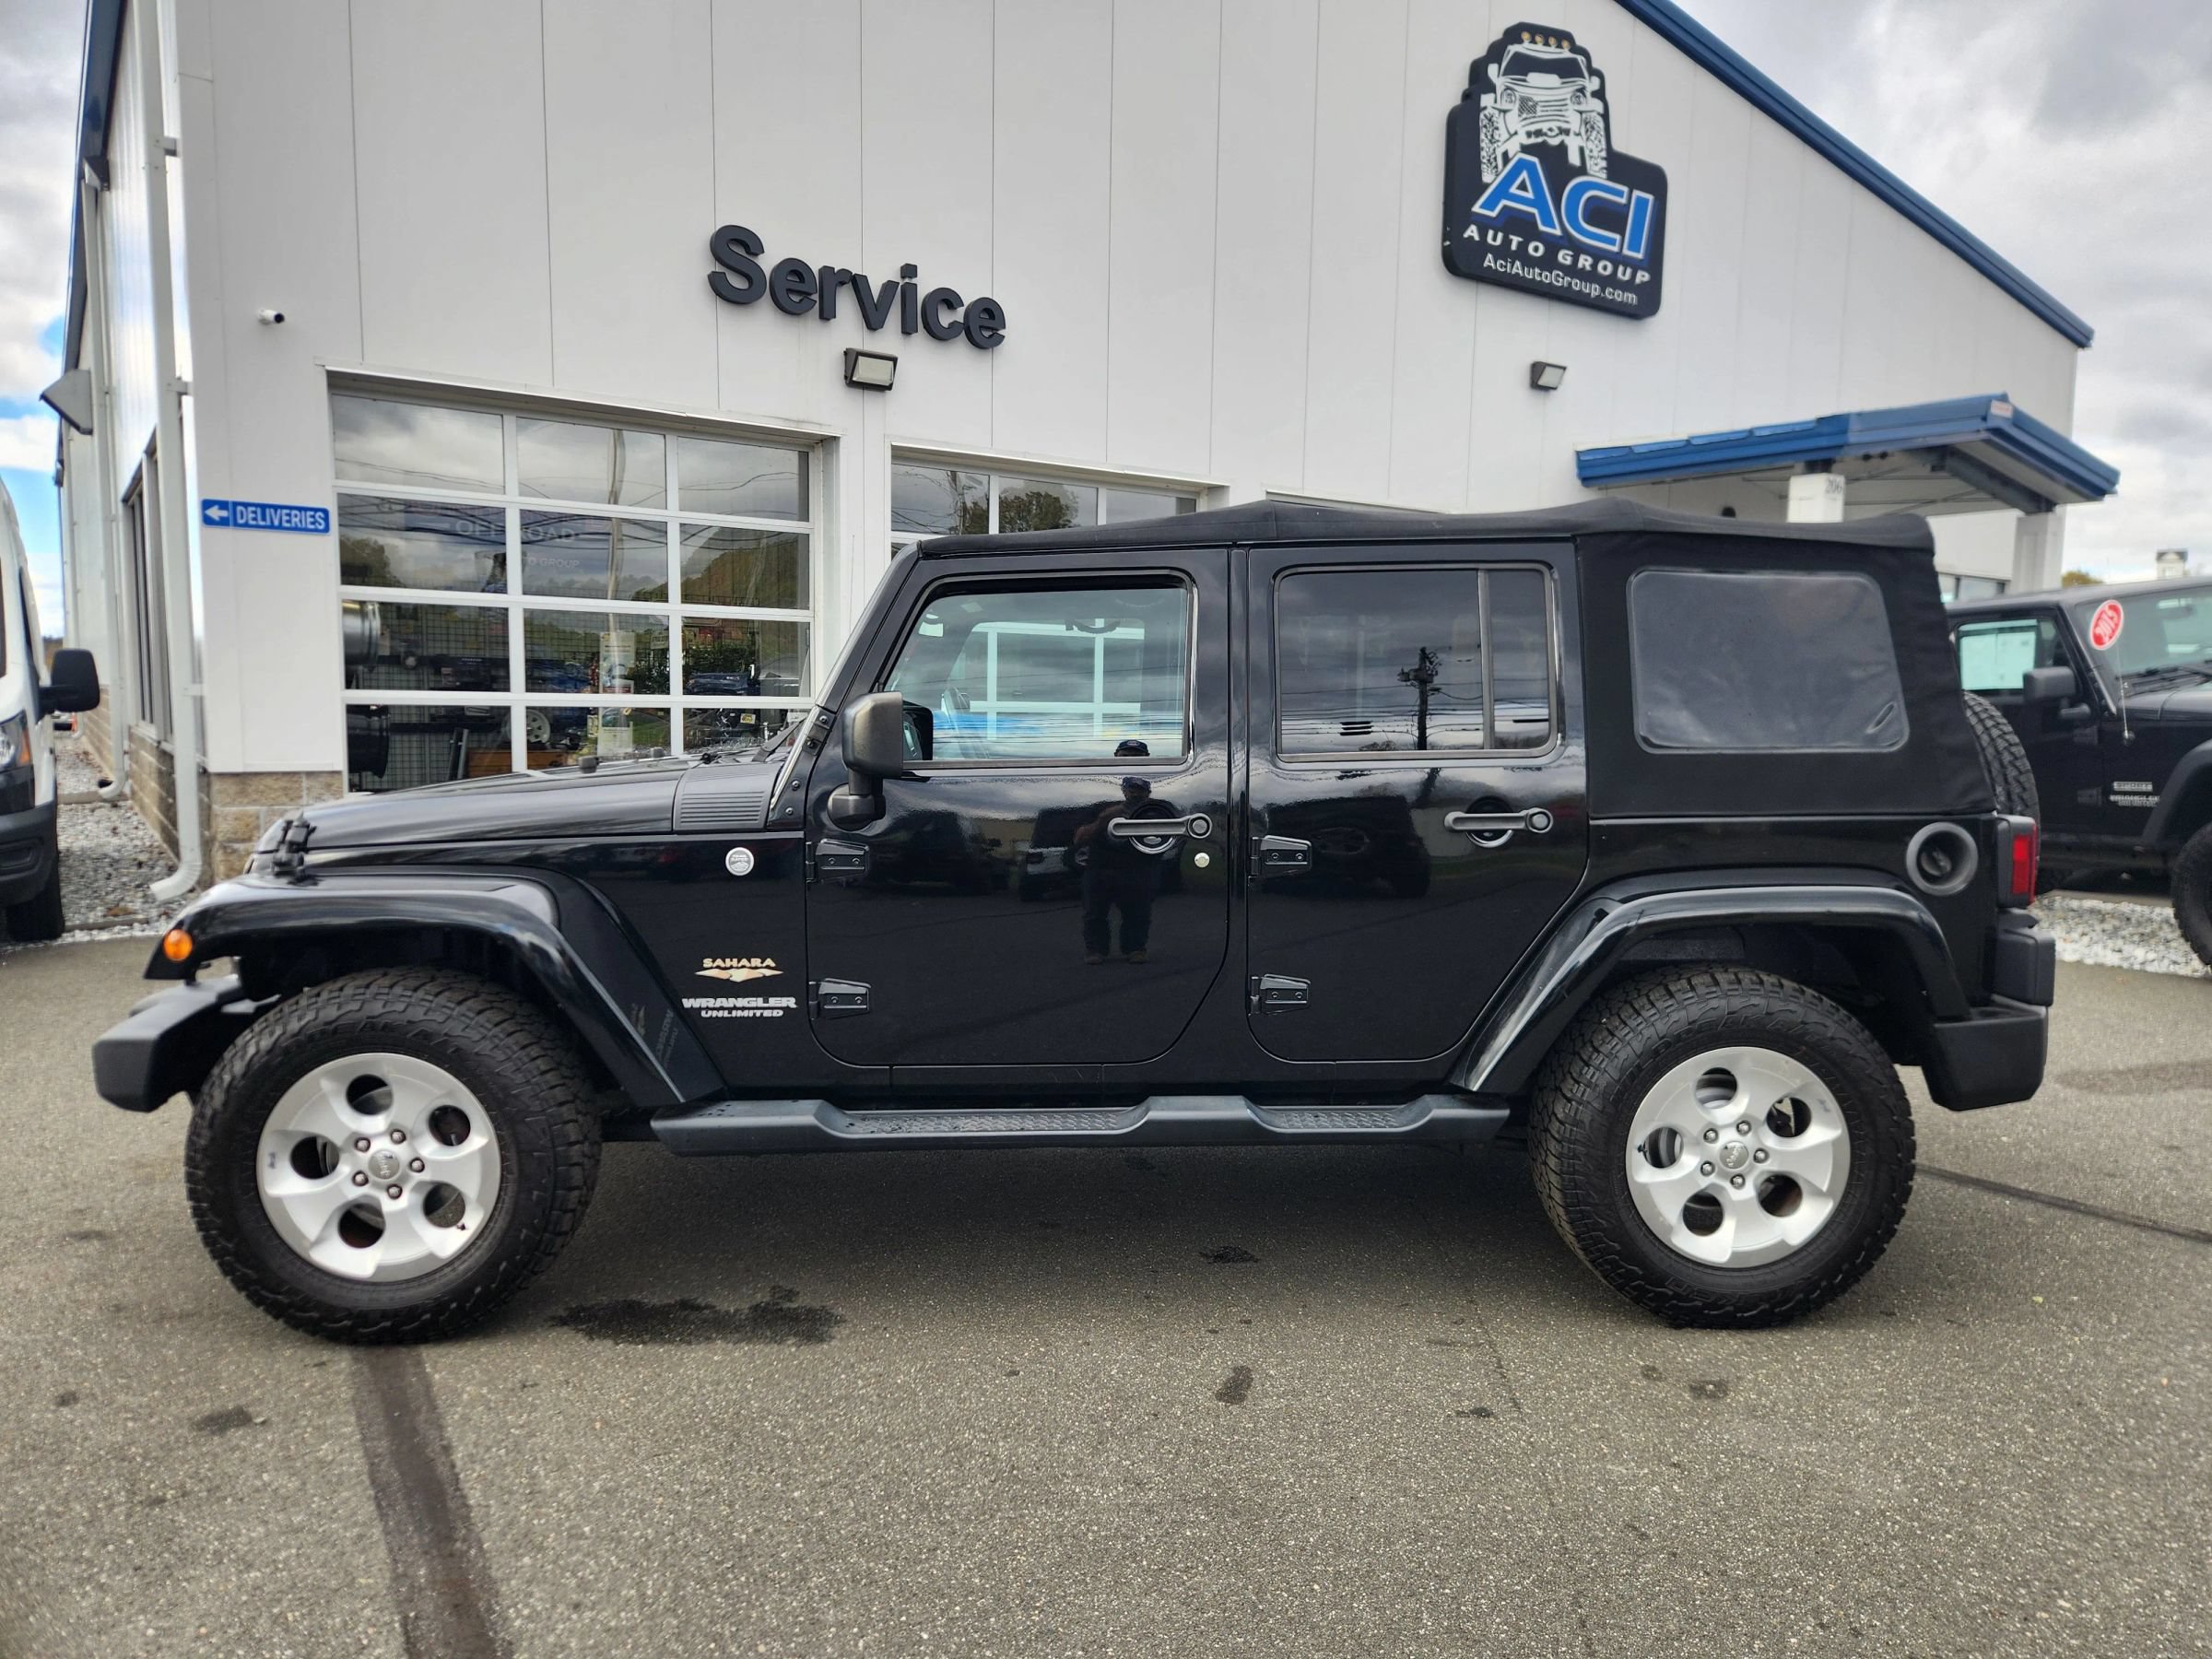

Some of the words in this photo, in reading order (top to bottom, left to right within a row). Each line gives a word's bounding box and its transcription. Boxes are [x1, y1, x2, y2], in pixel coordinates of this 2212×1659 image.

[1471, 152, 1654, 260] ACI
[1462, 224, 1546, 258] AUTO
[1557, 248, 1652, 286] GROUP
[707, 224, 1006, 349] Service
[1483, 253, 1638, 305] AciAutoGroup.com
[235, 505, 326, 530] DELIVERIES
[702, 958, 776, 968] SAHARA
[681, 996, 797, 1009] WRANGLER
[700, 1009, 784, 1018] UNLIMITED
